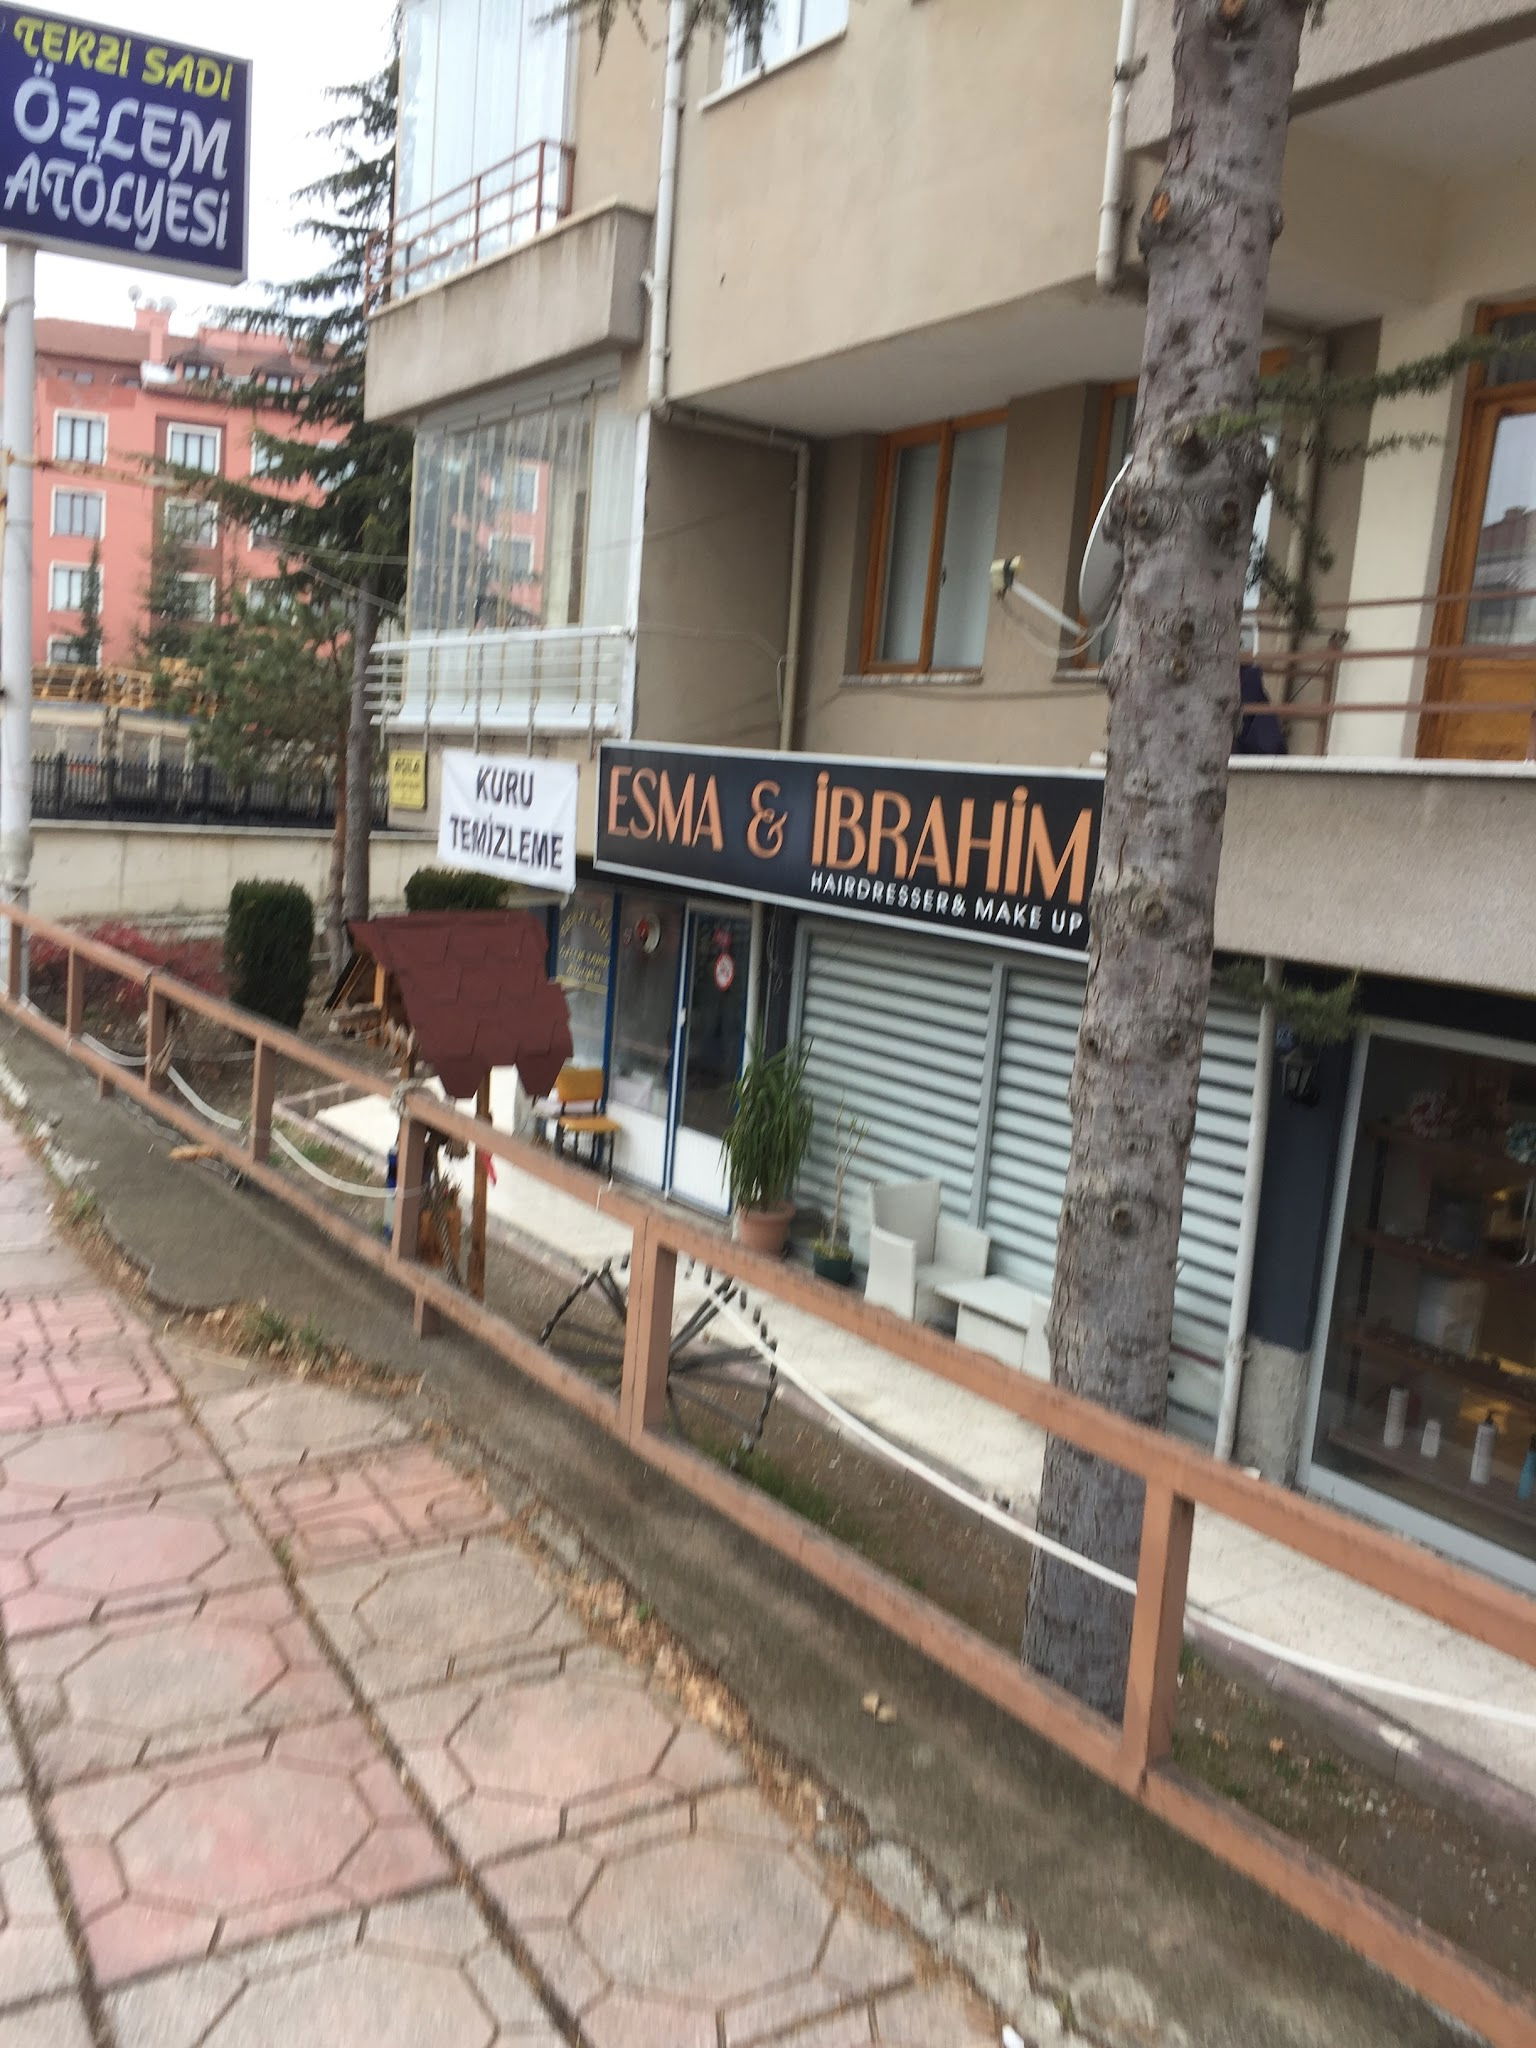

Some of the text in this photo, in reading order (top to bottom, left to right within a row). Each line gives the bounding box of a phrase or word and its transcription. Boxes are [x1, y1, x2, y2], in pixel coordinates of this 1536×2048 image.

[13, 59, 231, 181] ÖZLEM
[3, 147, 229, 251] ATÖLYESİ
[475, 765, 534, 807] KURU
[449, 811, 563, 870] TEMİZLEME
[607, 765, 1093, 906] ESMA & İBRAHİM
[974, 896, 1042, 930] MAKE
[1051, 908, 1083, 936] UP
